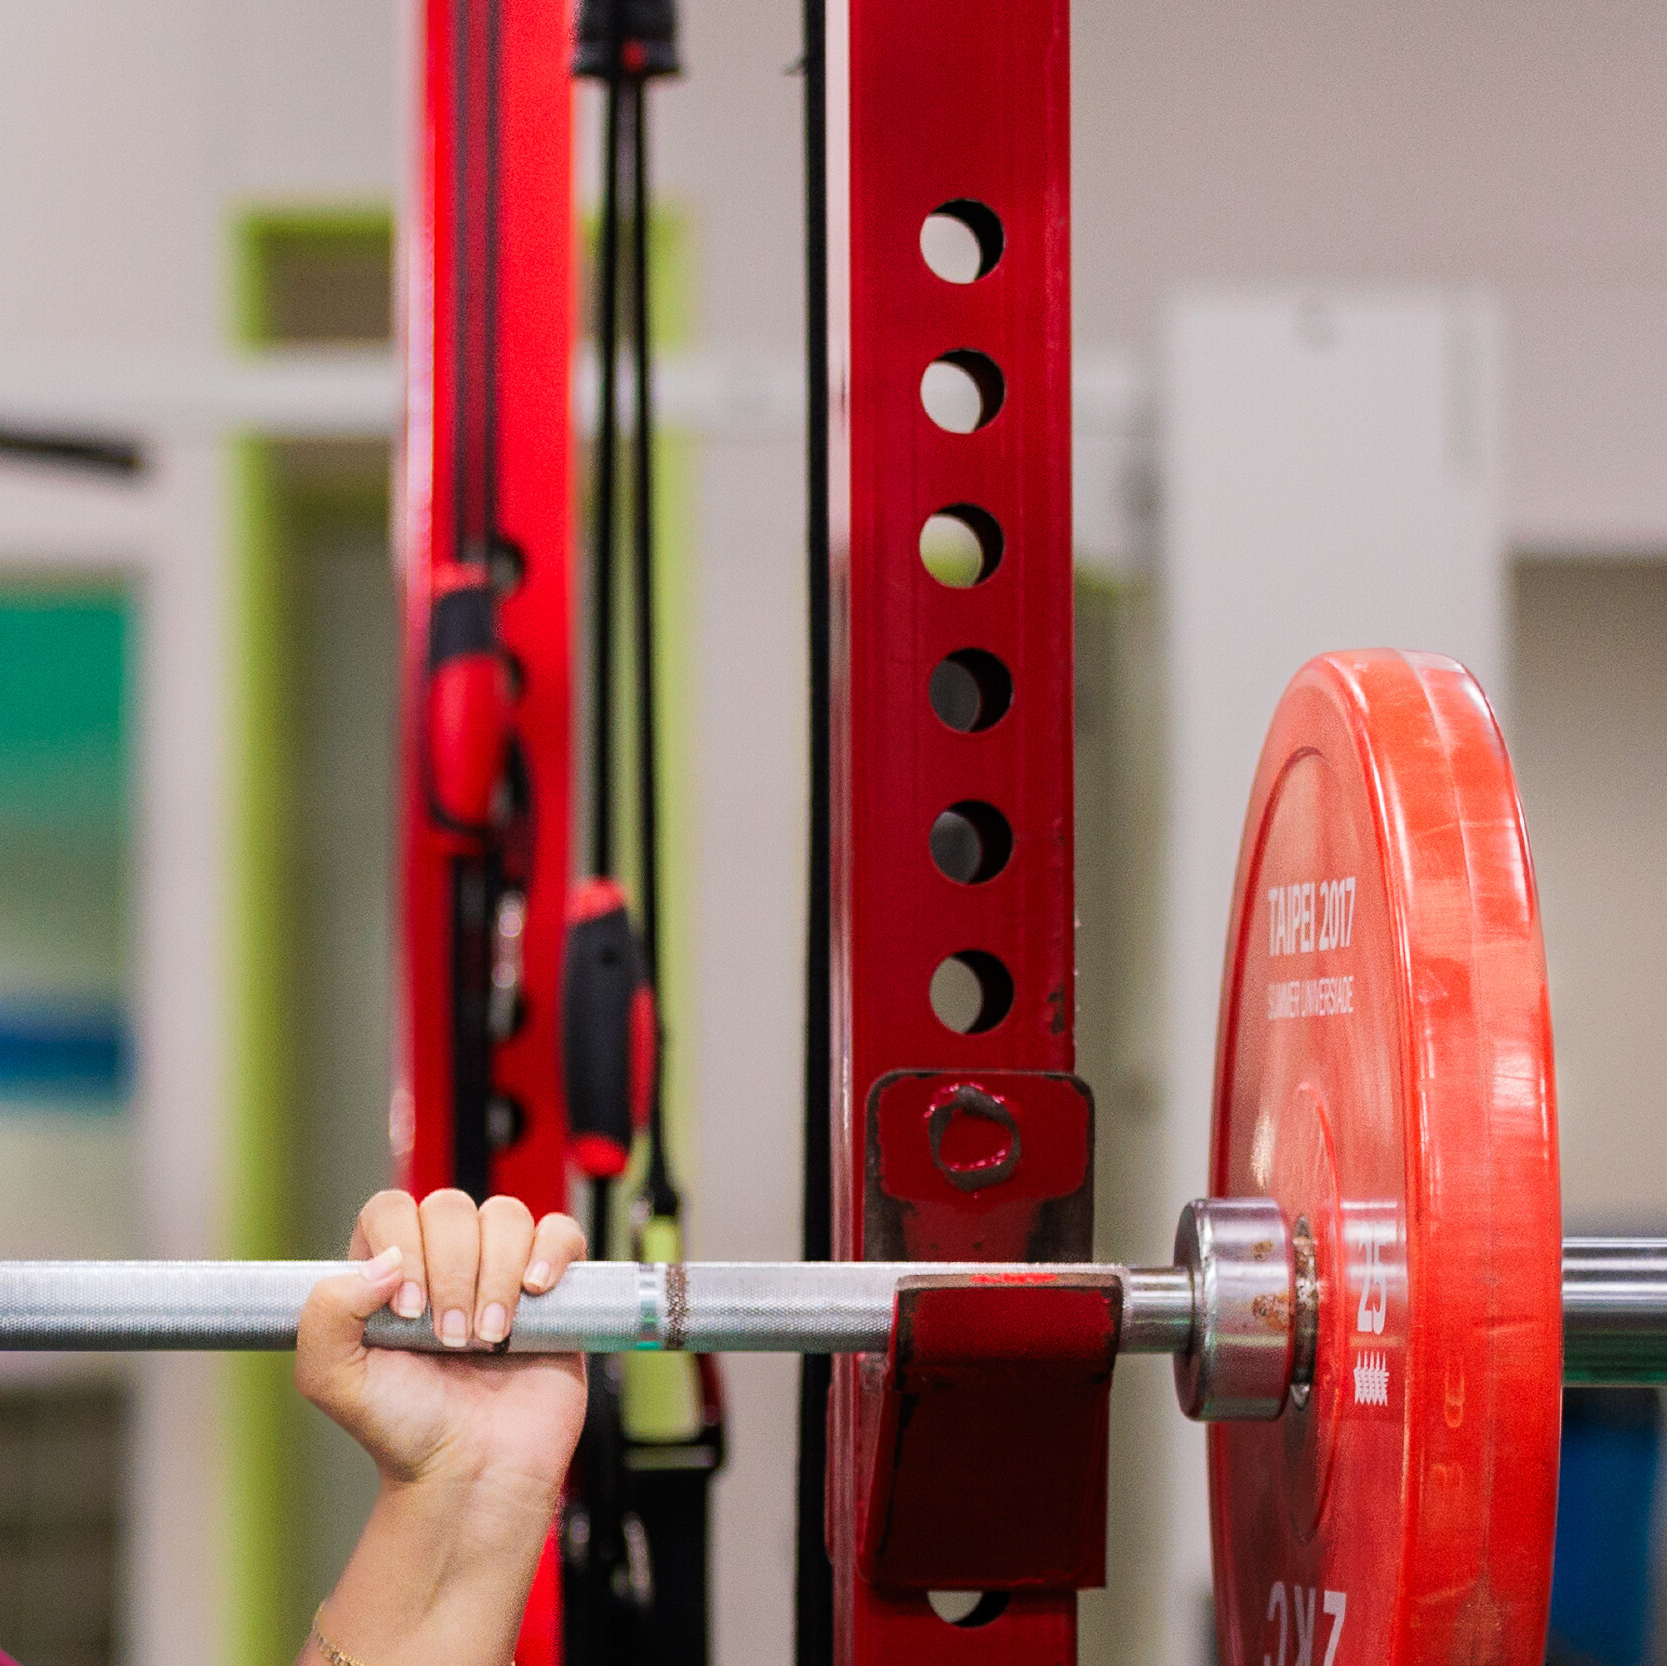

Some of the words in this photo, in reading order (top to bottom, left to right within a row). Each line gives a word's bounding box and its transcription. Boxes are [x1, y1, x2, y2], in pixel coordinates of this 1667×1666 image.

[1268, 881, 1316, 957] TAIPEI
[1318, 876, 1356, 951] 2017
[1357, 1222, 1388, 1335] 25
